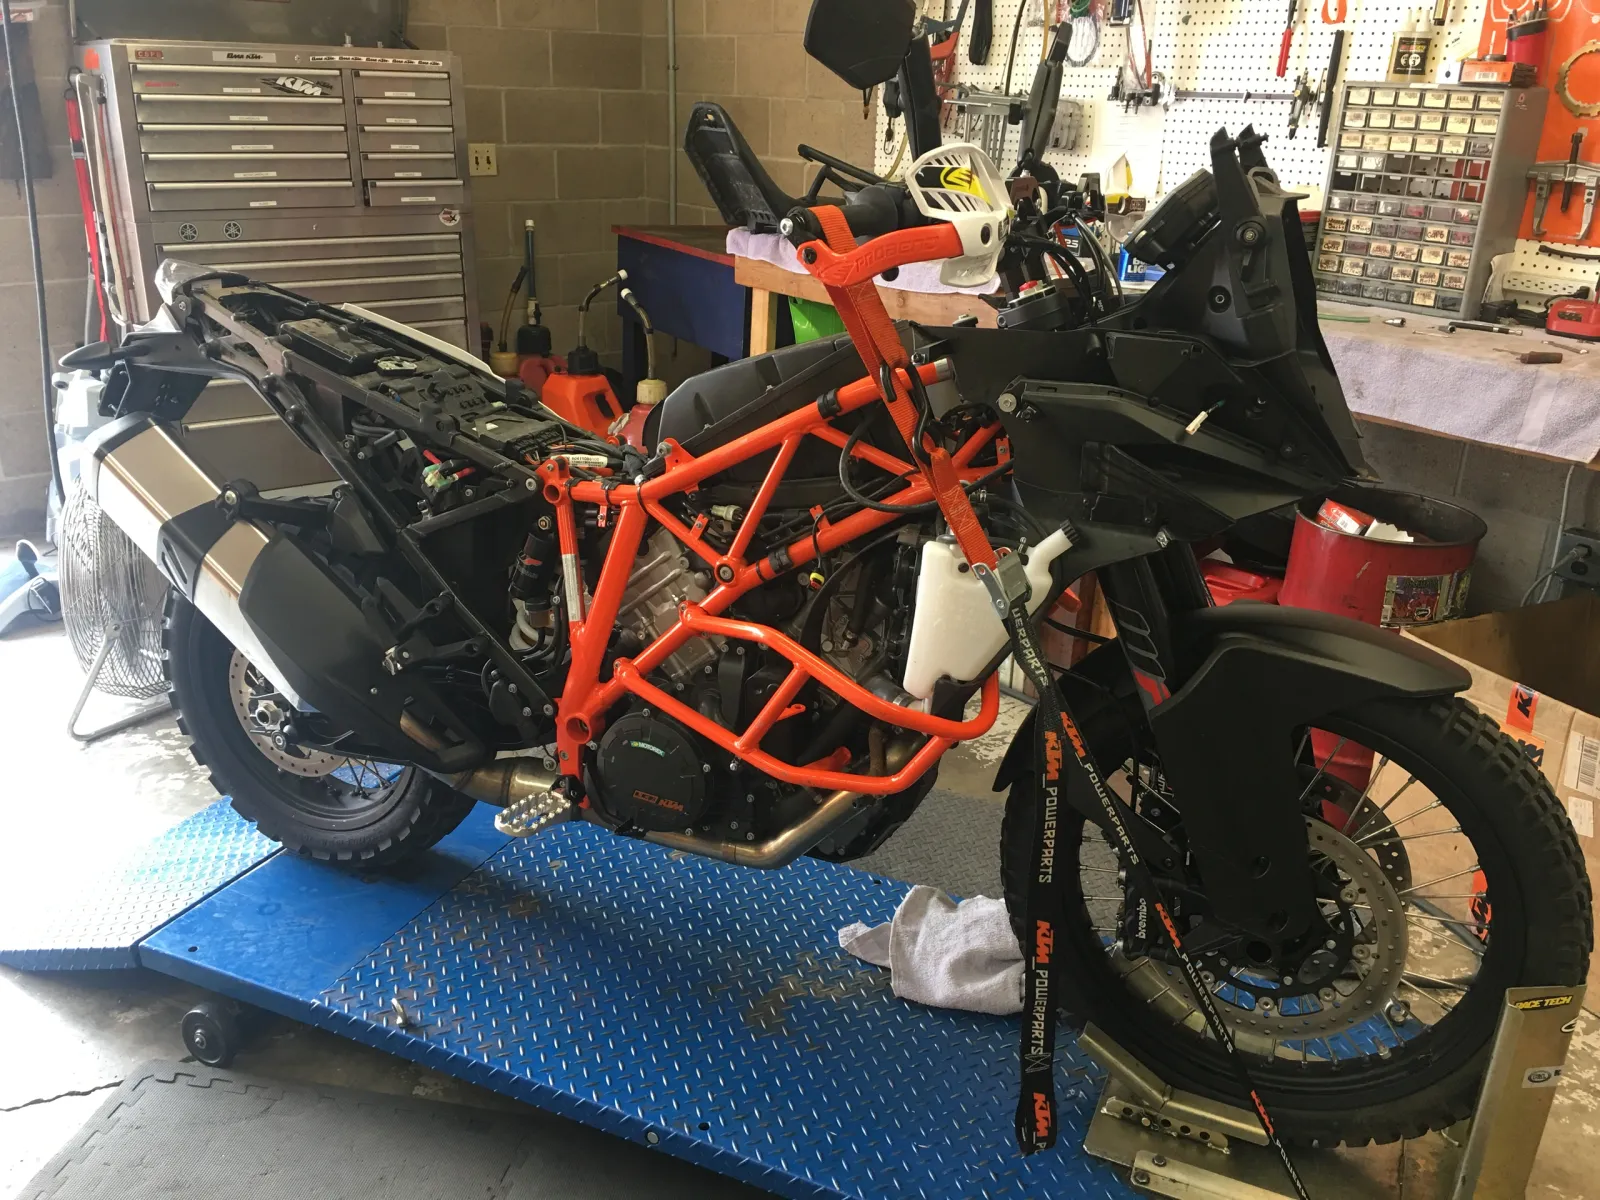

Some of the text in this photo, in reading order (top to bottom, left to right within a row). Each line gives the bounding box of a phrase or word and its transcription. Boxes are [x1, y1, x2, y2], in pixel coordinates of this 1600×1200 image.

[276, 77, 323, 96] KTM
[1039, 731, 1063, 883] KTM POWERPARTS
[1060, 712, 1139, 865] KTM POWERPARTS
[1135, 897, 1147, 939] brembo
[1031, 920, 1054, 1055] KTM POWERPARTS
[1181, 952, 1234, 1053] POWERPARTS
[1543, 996, 1573, 1006] TECH
[1033, 1092, 1051, 1137] KTM
